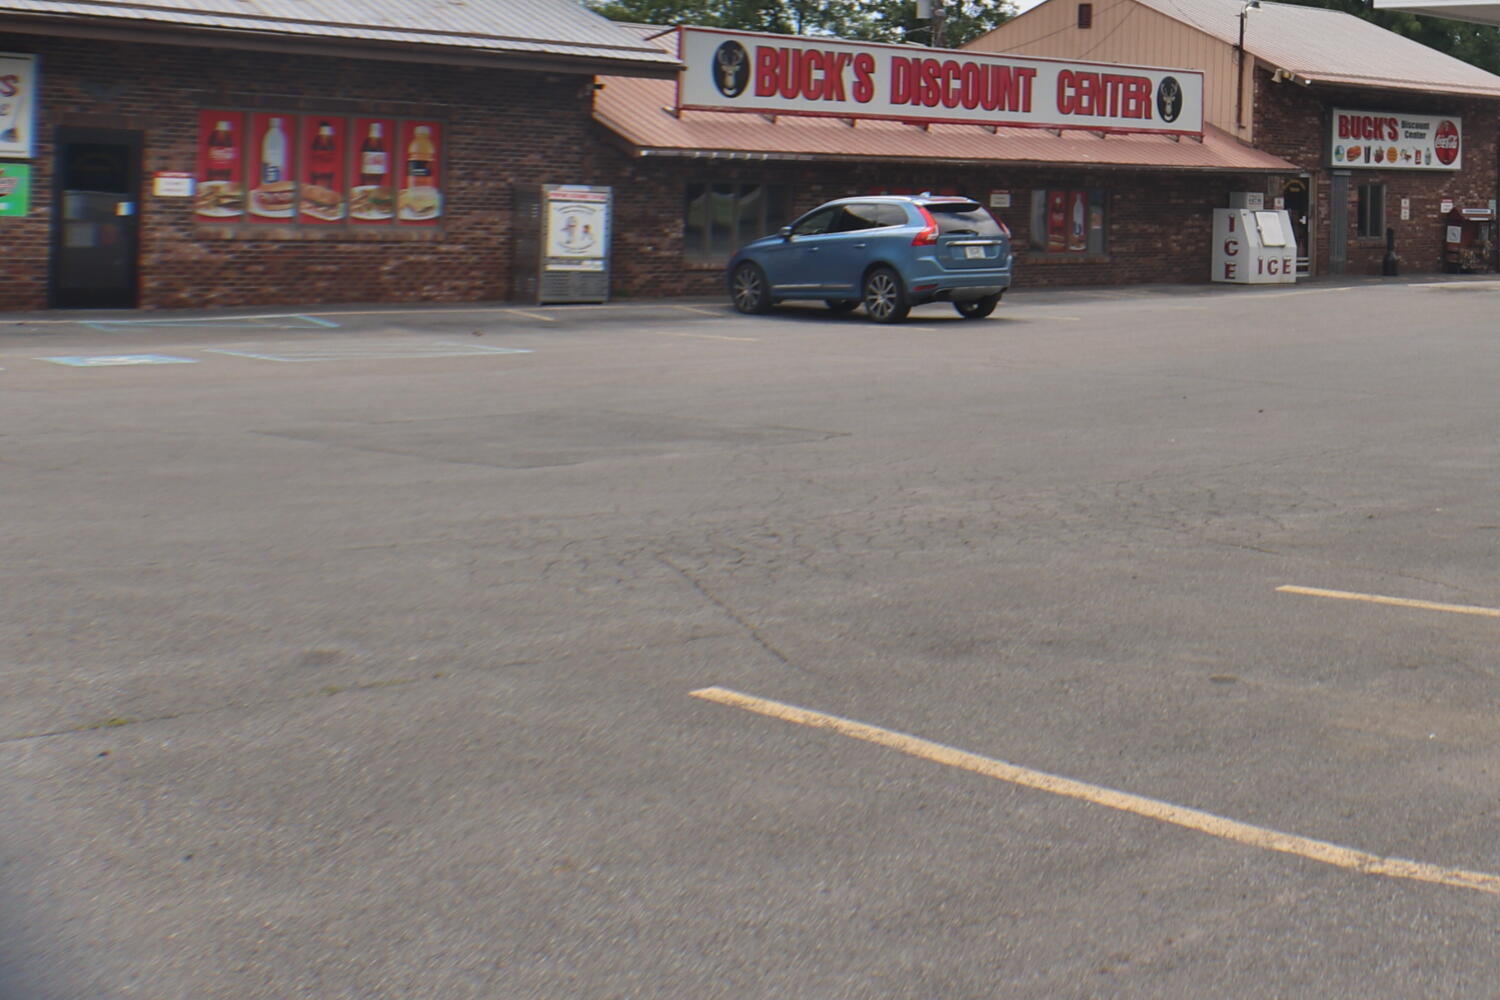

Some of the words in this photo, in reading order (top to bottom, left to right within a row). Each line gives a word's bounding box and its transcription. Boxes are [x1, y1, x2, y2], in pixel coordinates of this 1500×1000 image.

[754, 46, 875, 103] BUCK'S
[889, 56, 1037, 113] DISCOUNT
[1056, 69, 1153, 120] CENTER
[1338, 114, 1399, 141] BUCK'S
[1258, 258, 1292, 275] ICE
